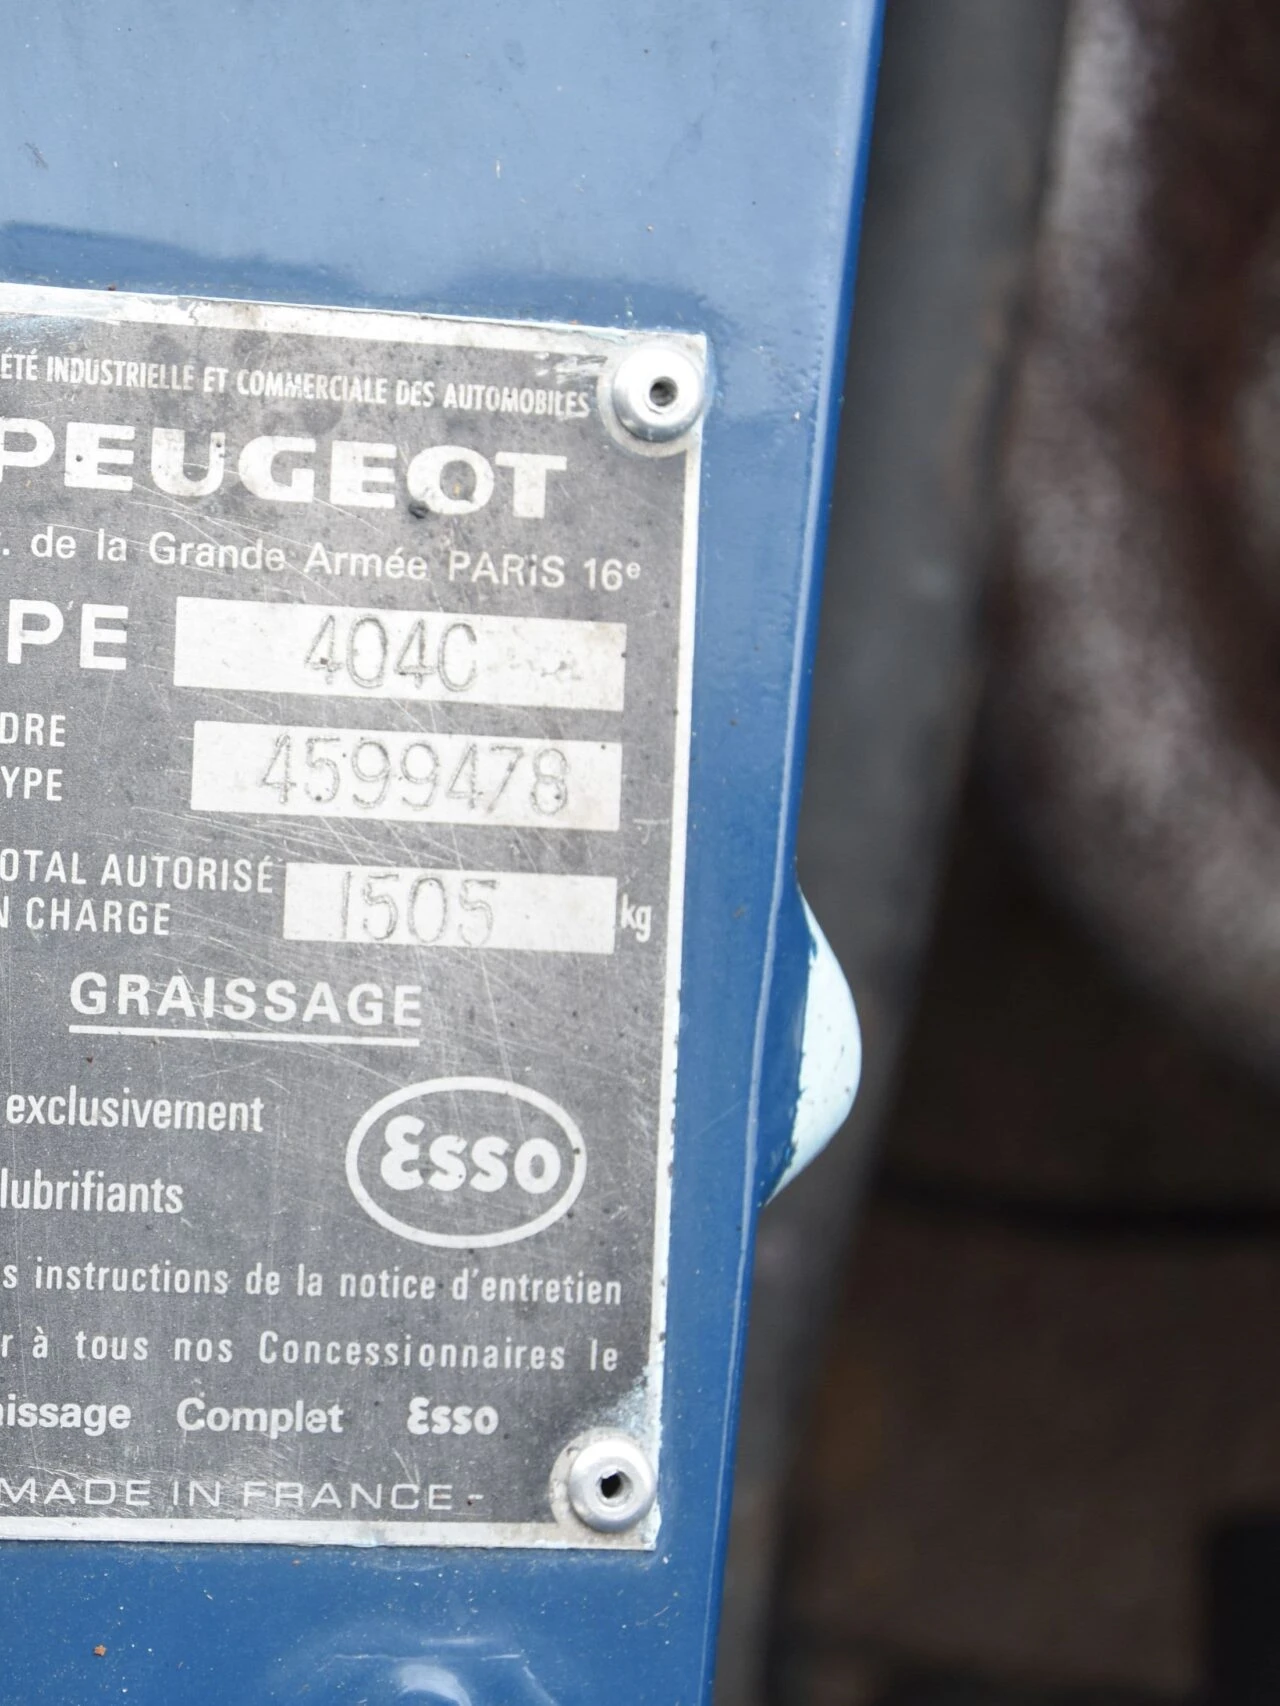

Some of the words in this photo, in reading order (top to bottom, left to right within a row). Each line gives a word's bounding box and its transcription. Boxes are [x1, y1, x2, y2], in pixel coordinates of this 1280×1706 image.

[46, 356, 195, 390] INDUSTRIELLE
[203, 369, 230, 392] ET
[237, 369, 390, 402] COMMERCIALE
[396, 379, 434, 405] DES
[443, 382, 590, 417] AUTOMOBILES
[31, 524, 76, 560] de
[97, 527, 127, 562] la
[149, 531, 285, 573] Grande
[304, 542, 428, 580] Armée
[304, 615, 479, 692] 404C
[260, 733, 570, 817] 4599478
[101, 856, 274, 894] AUTORISÉ
[25, 898, 170, 936] CHARGE
[339, 871, 498, 946] 1505
[620, 894, 652, 942] kg
[70, 972, 423, 1028] GRAISSAGE
[5, 1085, 264, 1133] exclusivement
[380, 1115, 562, 1193] Esso
[0, 1169, 184, 1216] lubrifiants
[35, 1257, 229, 1296] instructions
[245, 1264, 282, 1298] de
[296, 1265, 322, 1299] la
[340, 1266, 435, 1301] notice
[452, 1271, 622, 1305] d'entretien
[32, 1326, 50, 1359] à
[75, 1333, 148, 1362] tous
[174, 1336, 233, 1364] nos
[258, 1331, 565, 1370] Concessionnaires
[589, 1338, 618, 1373] le
[177, 1398, 343, 1437] Complet
[407, 1398, 499, 1437] Esso
[172, 1481, 222, 1508] IN
